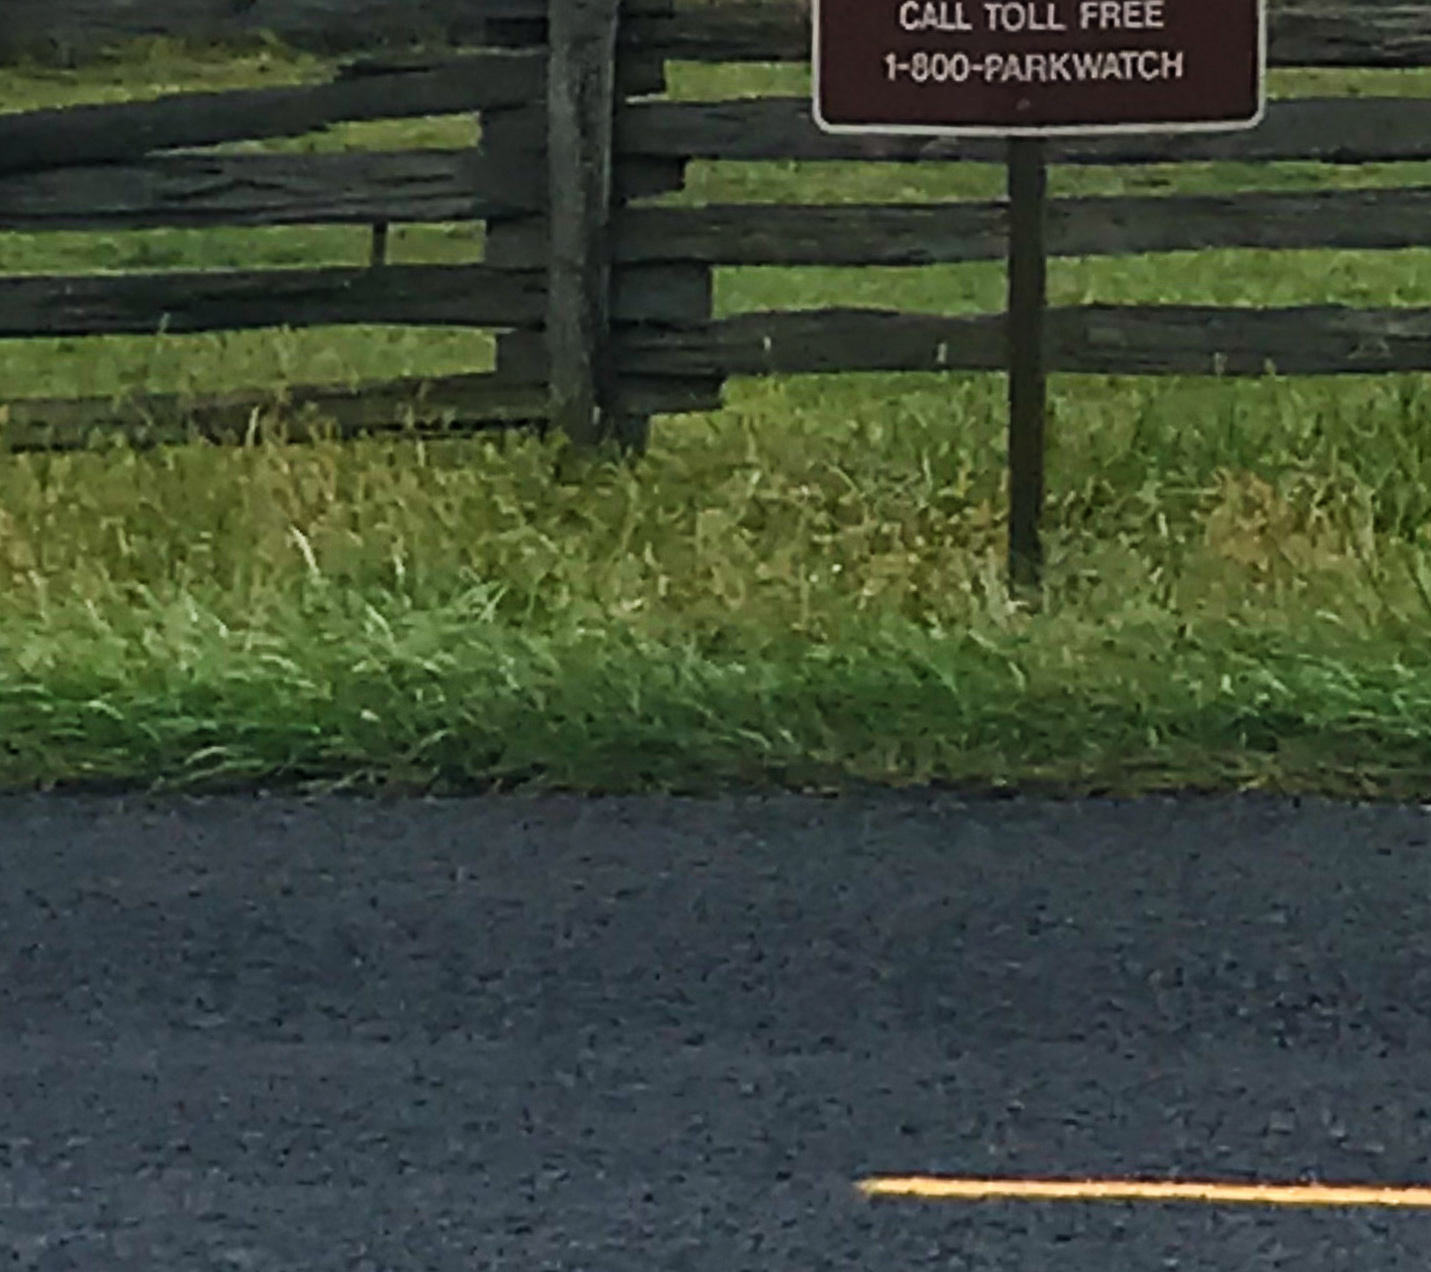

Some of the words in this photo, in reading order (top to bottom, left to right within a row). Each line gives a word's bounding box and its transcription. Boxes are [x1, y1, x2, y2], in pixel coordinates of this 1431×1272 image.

[899, 0, 973, 31] CALL
[984, 0, 1066, 31] TOLL
[1080, 0, 1166, 29] FREE
[883, 51, 1185, 82] 1-800-PARKWATCH
